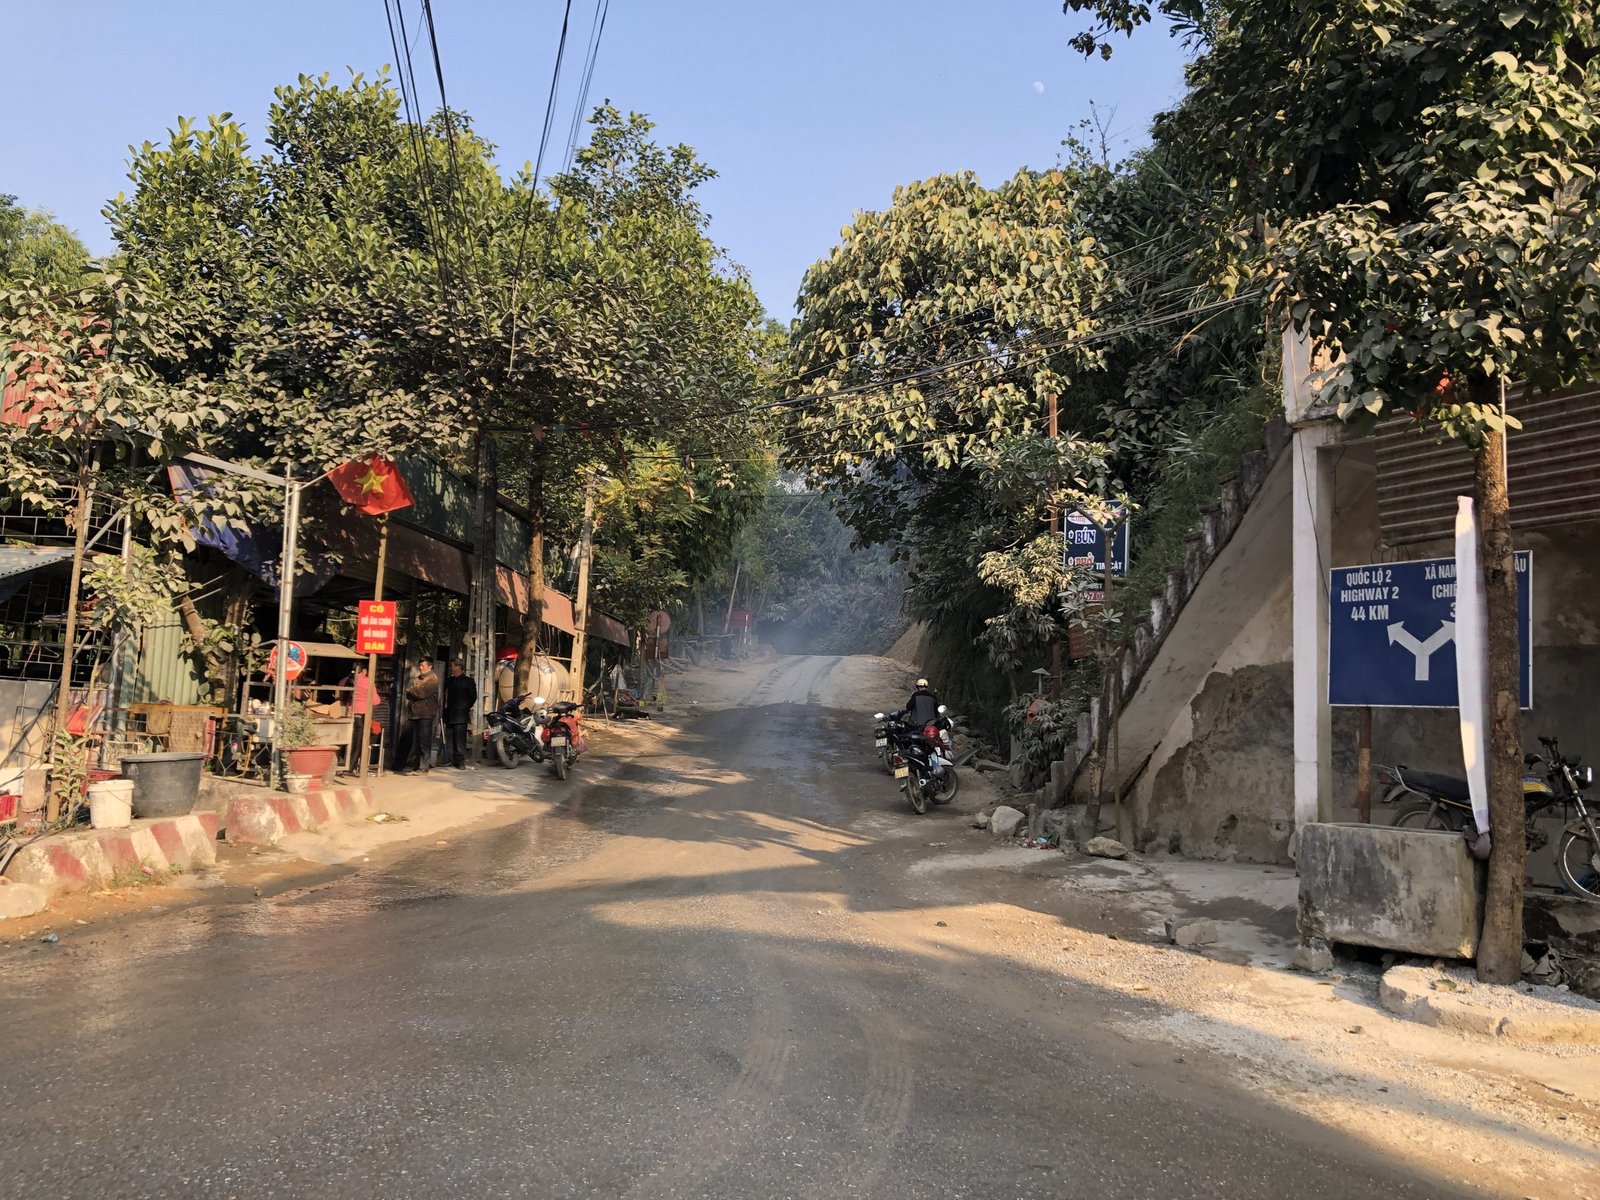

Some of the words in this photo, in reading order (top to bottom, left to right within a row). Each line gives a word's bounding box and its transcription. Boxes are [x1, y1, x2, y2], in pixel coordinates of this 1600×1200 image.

[1075, 526, 1096, 544] BÚN
[1346, 568, 1370, 587] QUỐC
[1372, 568, 1383, 585] LỘ
[1385, 569, 1392, 583] 2
[1425, 563, 1436, 580] XÃ
[1341, 586, 1389, 602] HIGHWAY
[1391, 586, 1399, 599] 2
[1351, 606, 1366, 621] 44
[1369, 604, 1389, 620] KM
